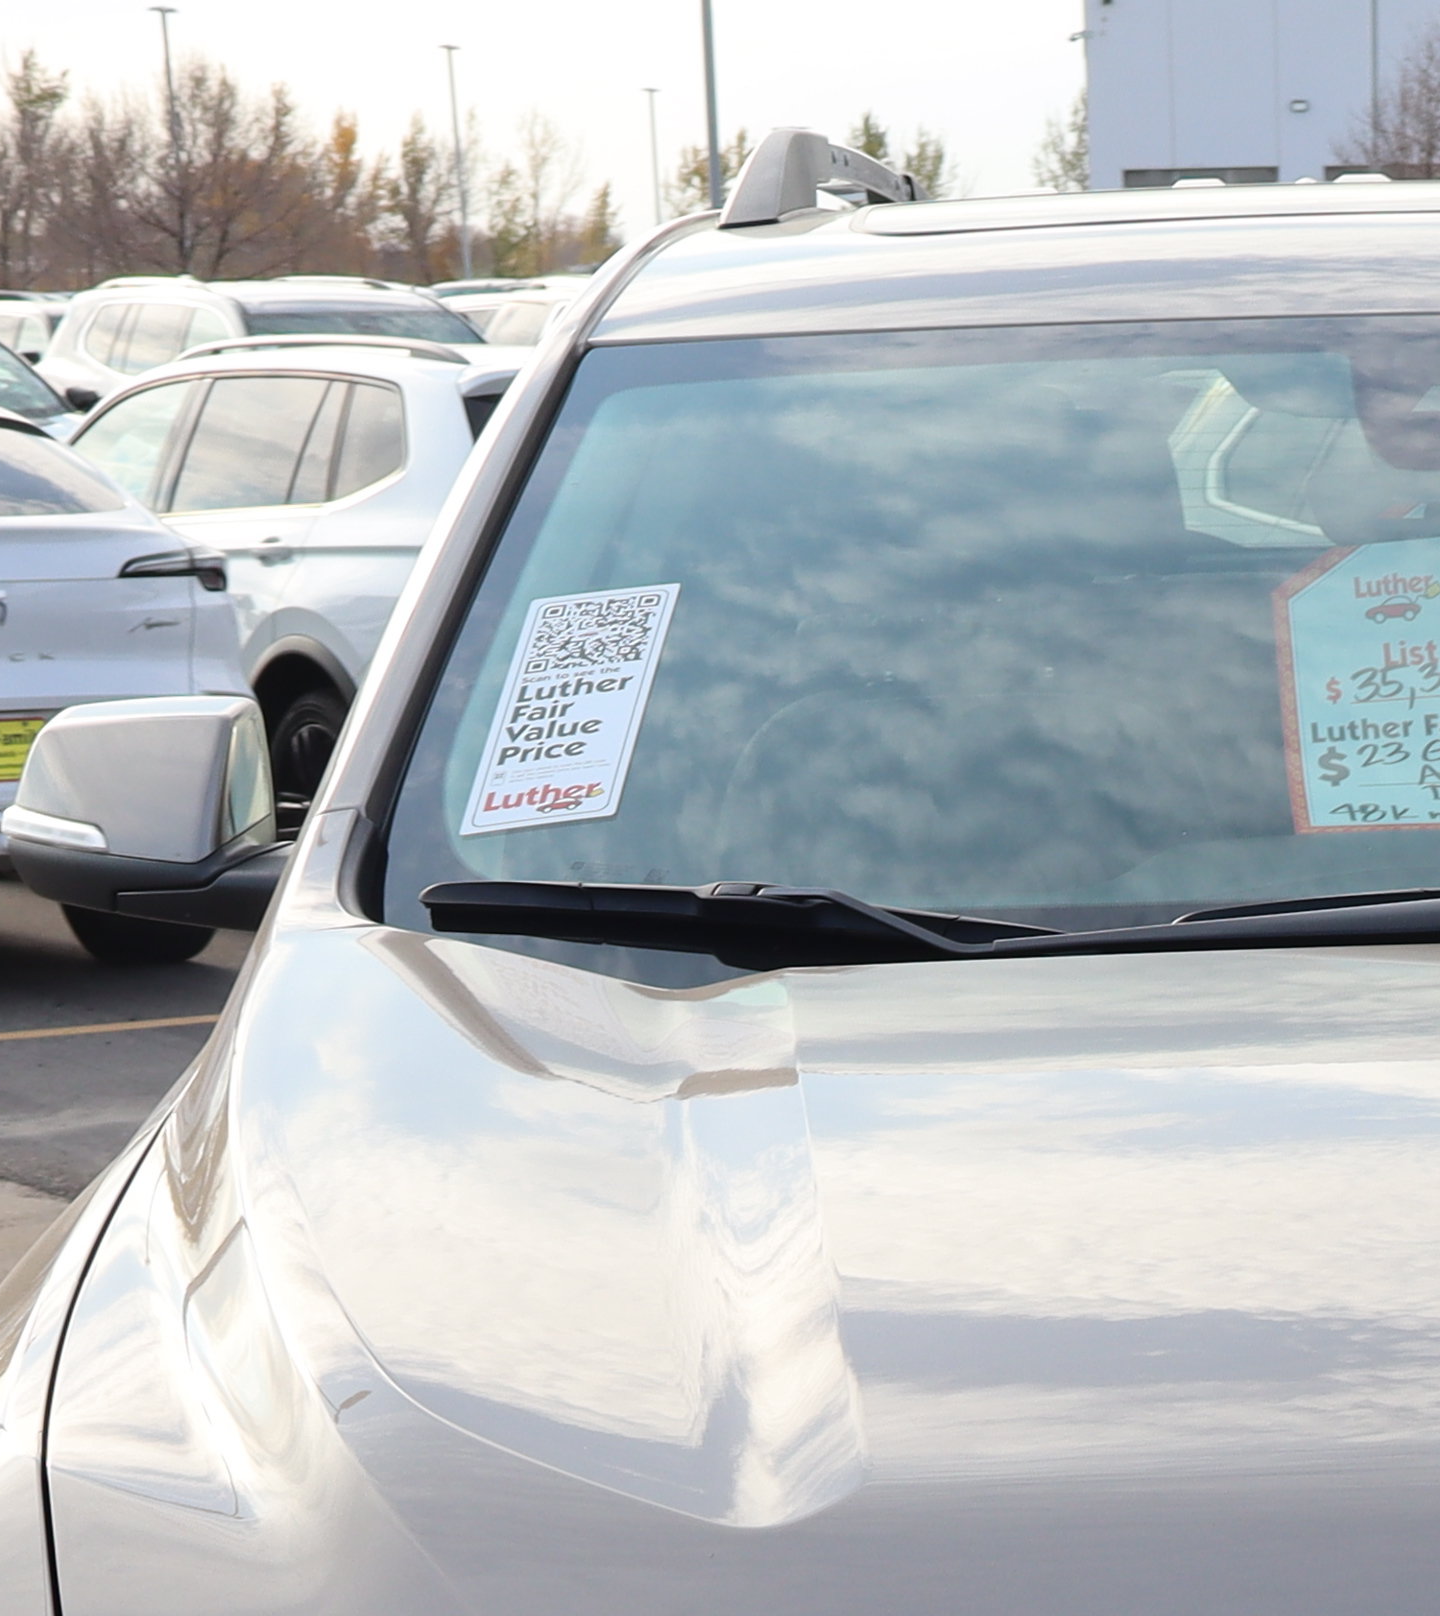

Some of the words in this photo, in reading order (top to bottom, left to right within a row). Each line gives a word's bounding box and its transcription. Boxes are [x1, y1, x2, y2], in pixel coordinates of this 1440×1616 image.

[1354, 573, 1435, 599] Luther
[1383, 641, 1438, 668] List
[556, 670, 570, 679] to
[516, 675, 634, 703] Luther
[509, 700, 575, 724] Fair
[505, 718, 603, 743] Value
[1311, 719, 1414, 743] Luther
[496, 741, 587, 766] Price
[1356, 741, 1410, 768] 23
[483, 781, 603, 812] Luther
